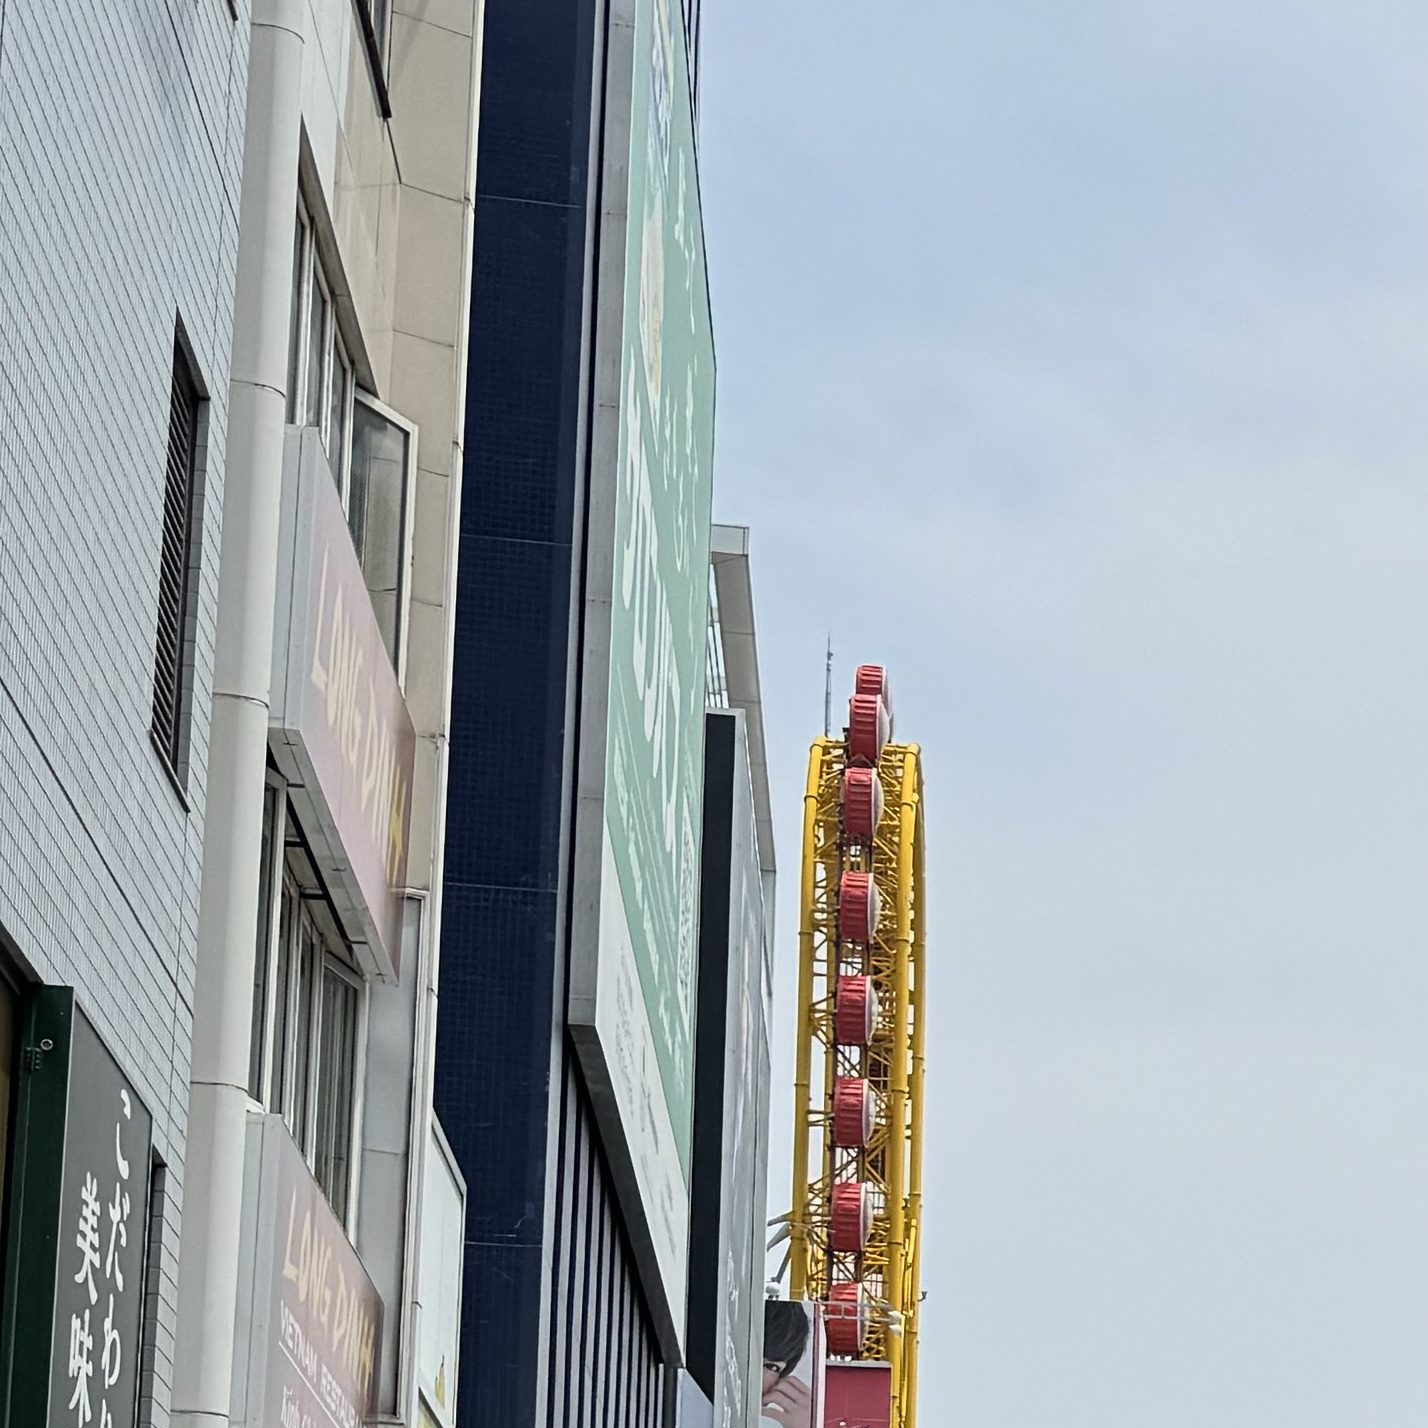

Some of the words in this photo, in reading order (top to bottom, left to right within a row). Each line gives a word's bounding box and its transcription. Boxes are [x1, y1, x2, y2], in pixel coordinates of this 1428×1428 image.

[311, 542, 363, 793] LONG
[280, 1299, 318, 1384] VIETNAM
[283, 1185, 332, 1330] LONG
[333, 1263, 375, 1398] DINH
